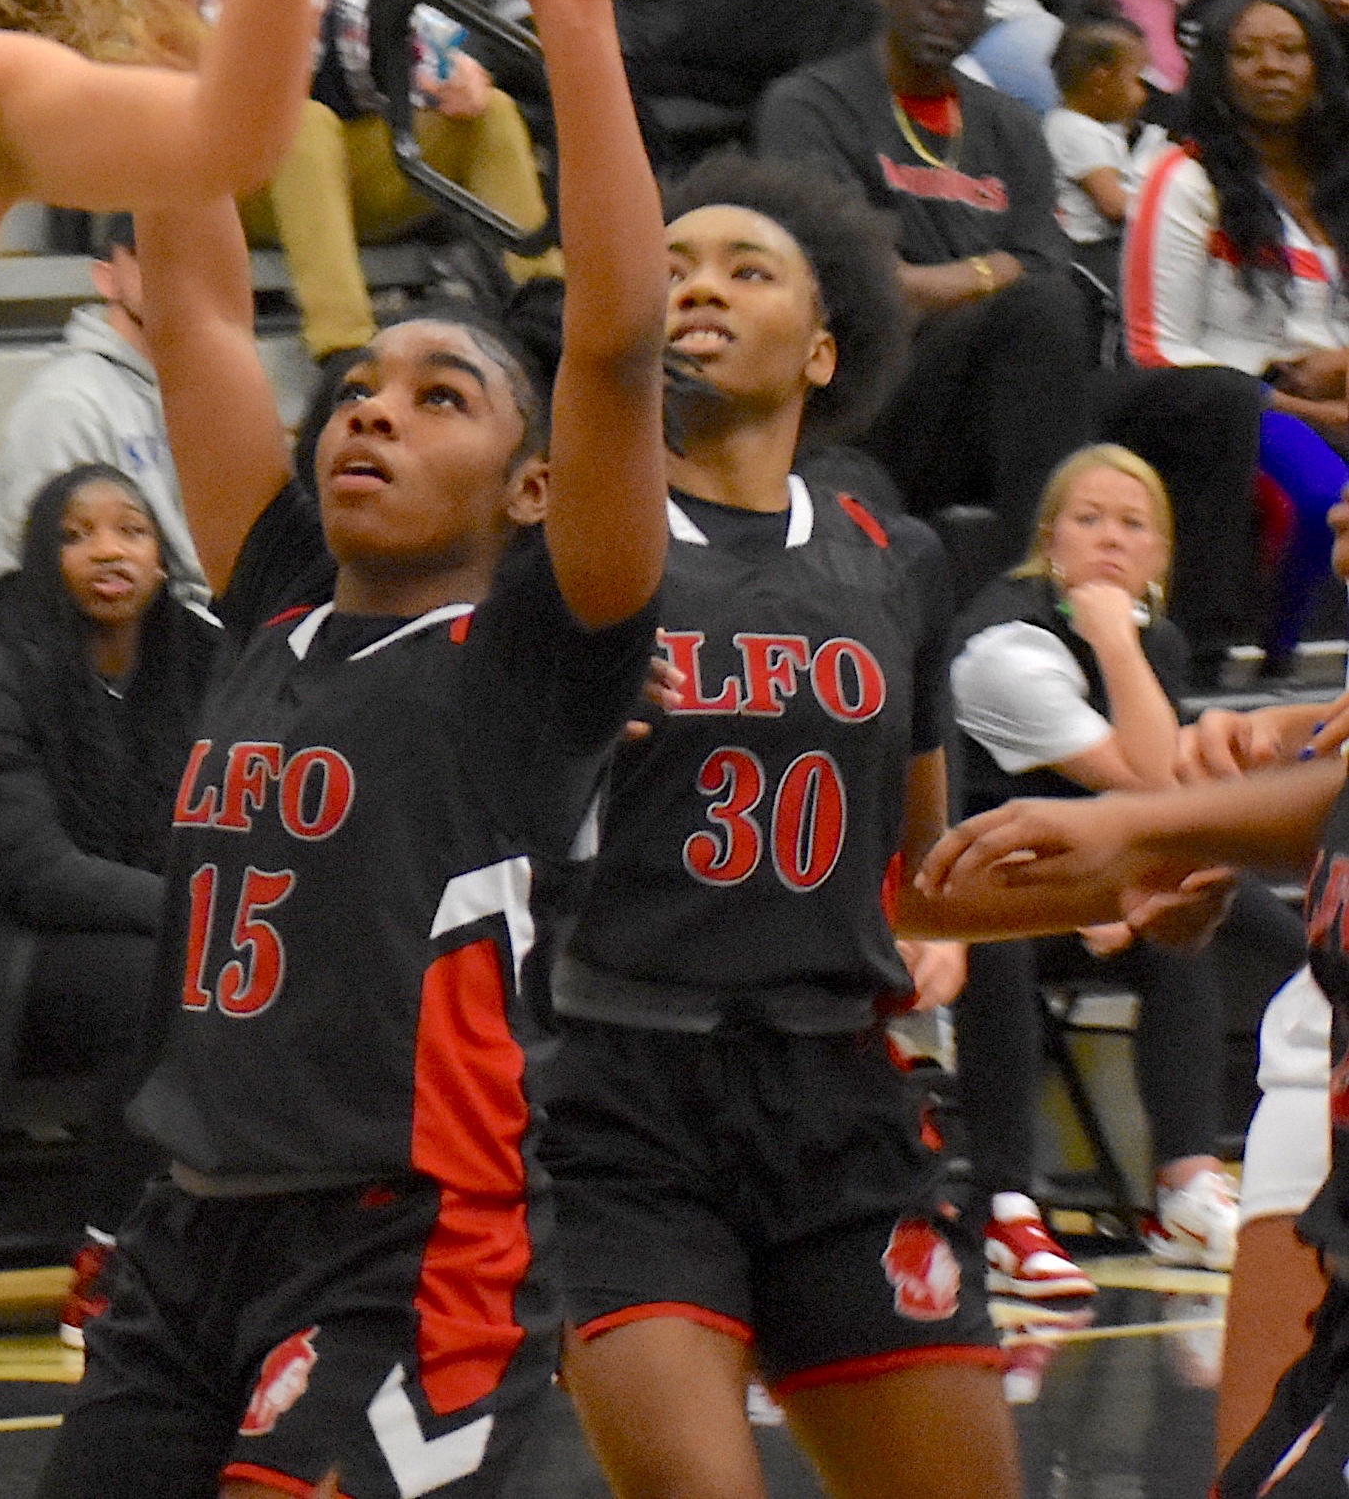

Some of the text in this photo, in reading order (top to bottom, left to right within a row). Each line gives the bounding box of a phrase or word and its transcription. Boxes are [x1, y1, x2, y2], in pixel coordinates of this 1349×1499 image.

[656, 630, 887, 723] LFO
[171, 738, 355, 841] LFO
[682, 746, 847, 893] 30
[181, 862, 297, 1018] 15
